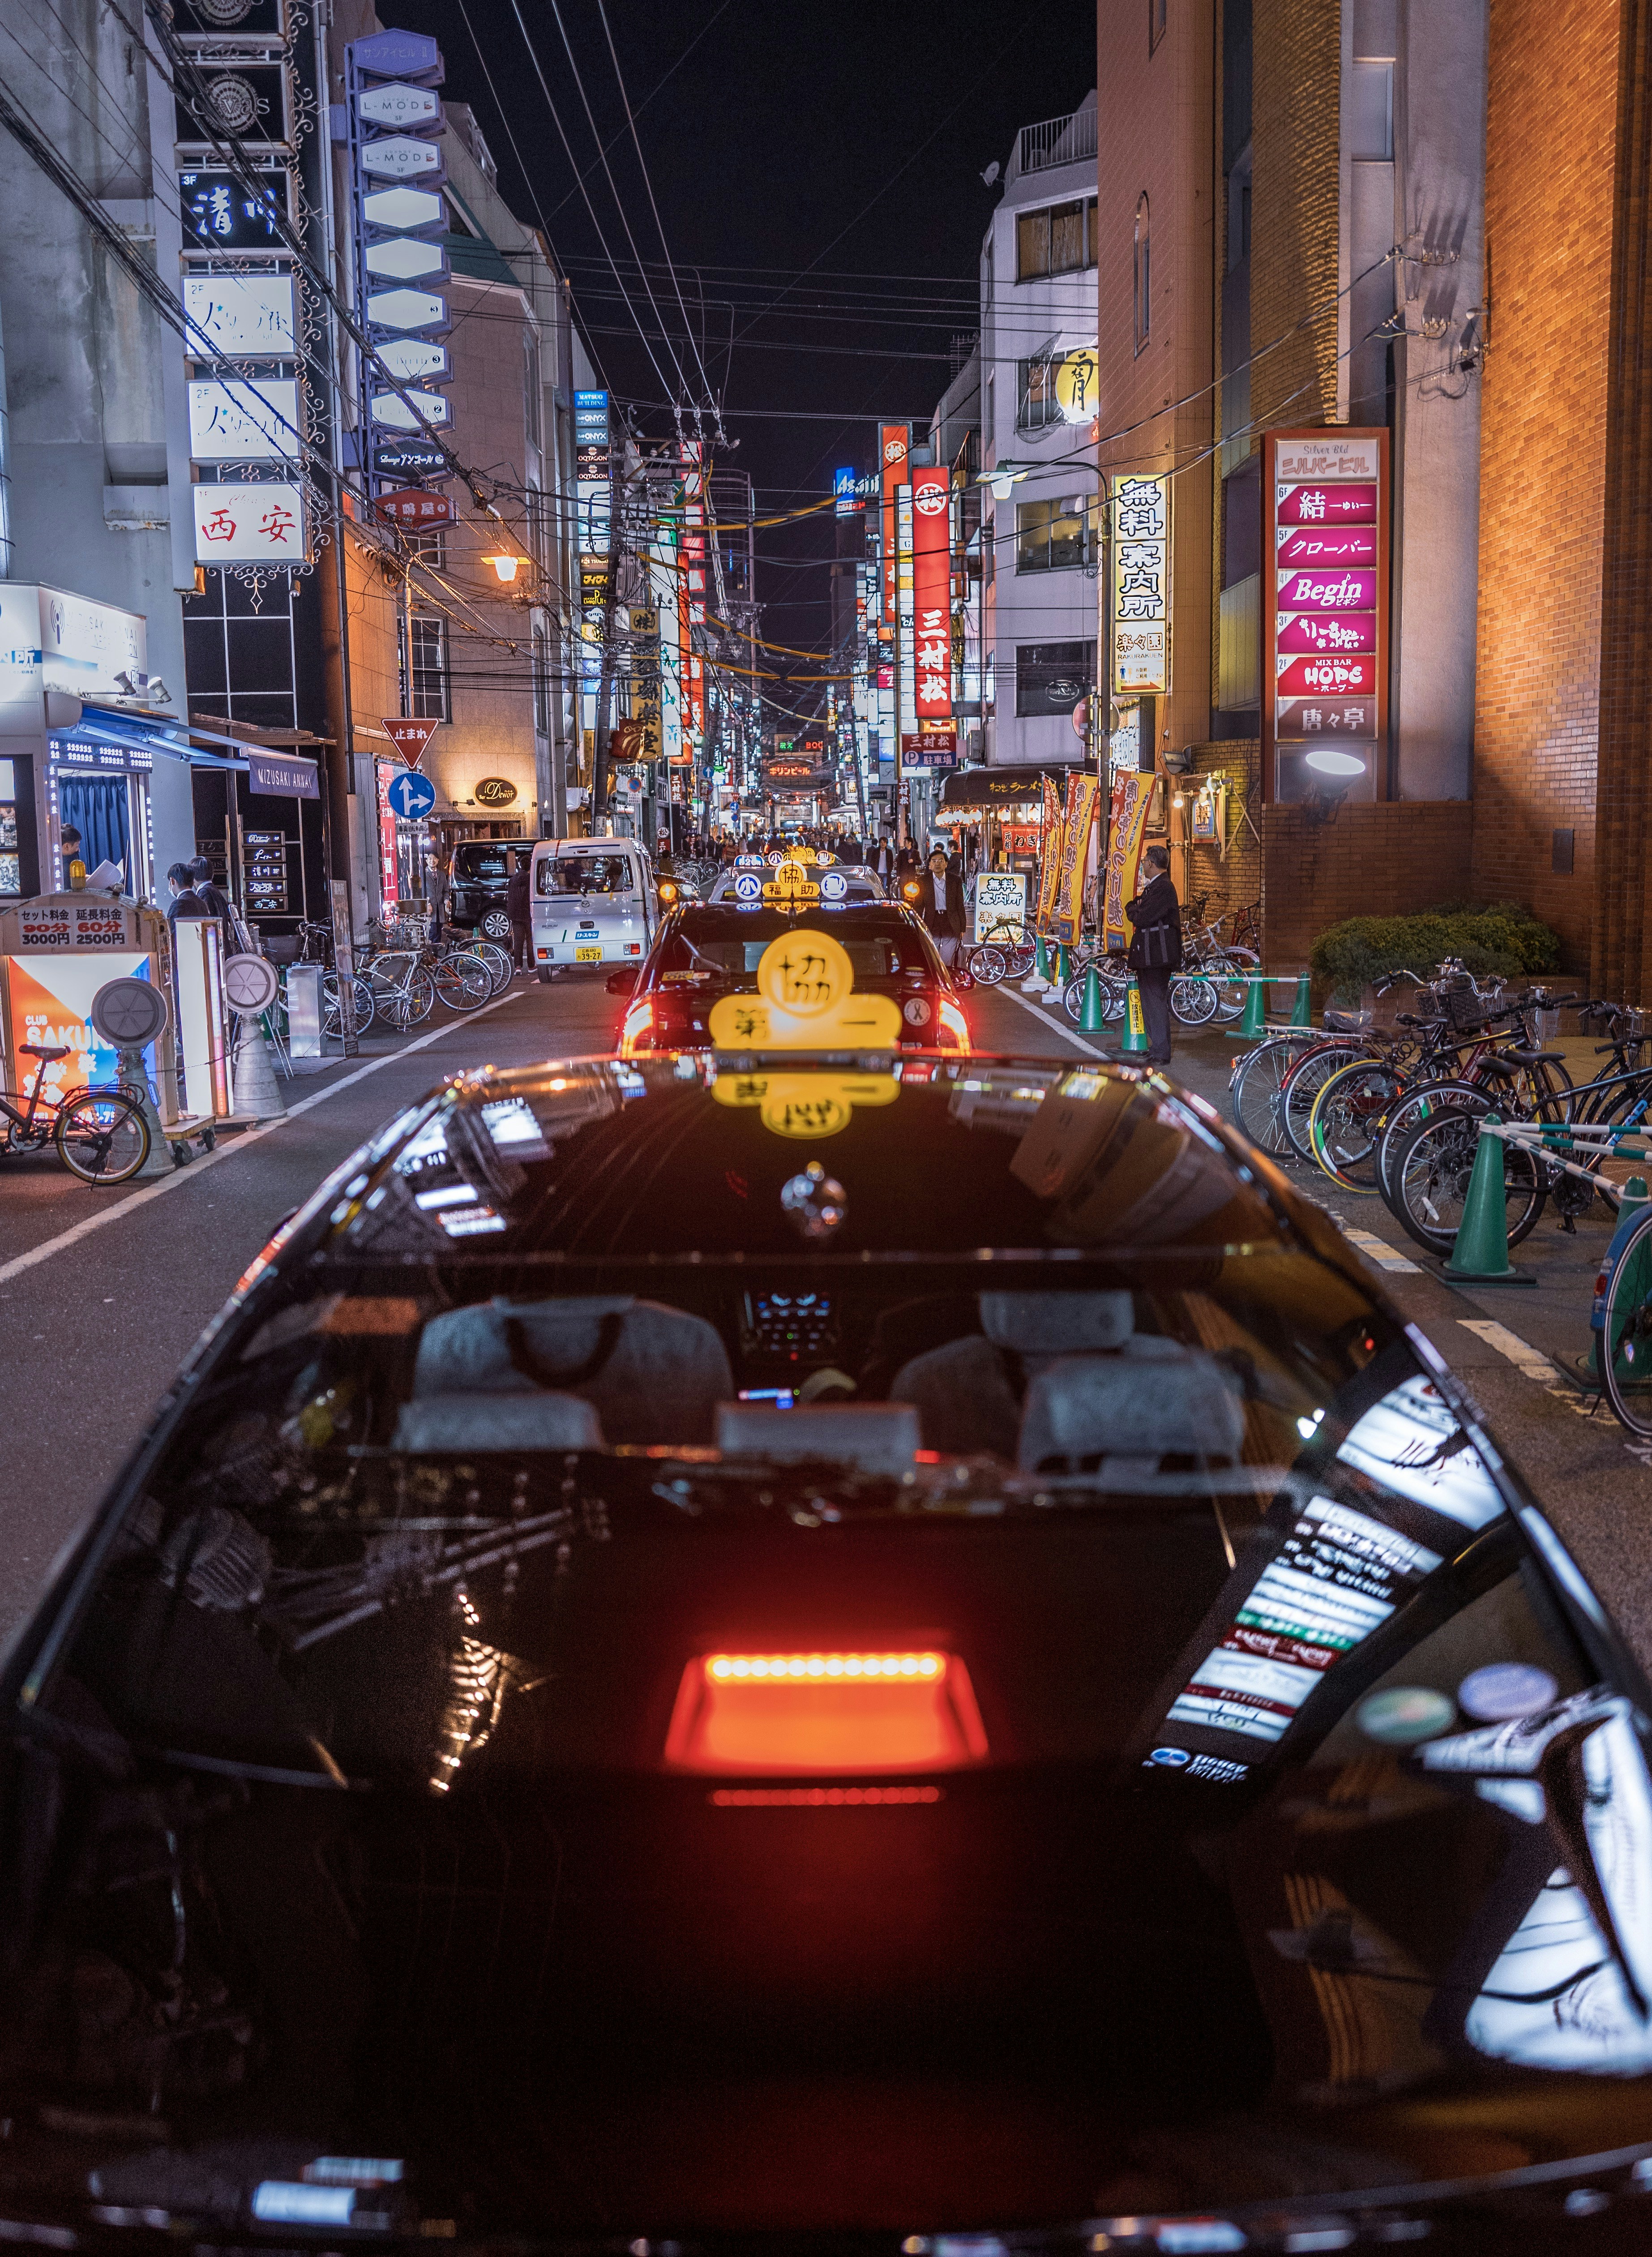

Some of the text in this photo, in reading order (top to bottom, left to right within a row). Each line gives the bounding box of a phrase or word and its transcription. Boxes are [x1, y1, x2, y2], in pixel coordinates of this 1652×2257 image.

[183, 175, 197, 185] 3F
[192, 285, 204, 295] 2F
[197, 389, 209, 398] 2F
[887, 444, 903, 459] 松
[1303, 445, 1349, 454] Silver Bld
[1279, 487, 1288, 498] 6F
[918, 487, 943, 511] 松
[1299, 491, 1326, 519] 結
[202, 505, 296, 543] 西安
[1279, 530, 1288, 541] 5F
[1118, 478, 1164, 619] 無料案内所
[1288, 540, 1372, 557] クローバー
[1279, 573, 1288, 584] 4F
[1292, 573, 1362, 607] Begin
[1336, 597, 1359, 606] ビギン
[1279, 616, 1288, 626] 3F
[917, 609, 949, 703] 三村松
[1279, 659, 1287, 670] 2F
[1304, 666, 1363, 685] HOPE
[1302, 707, 1365, 731] 唐々亭
[394, 728, 428, 739] 止まれ
[910, 734, 950, 747] 三村松
[908, 752, 916, 764] P
[923, 755, 952, 765] 駐車場
[769, 767, 811, 776] キリンビール
[258, 768, 312, 789] MIZUSAKI ANNAI
[484, 782, 514, 800] Dewor
[672, 775, 681, 801] 三村松
[899, 777, 909, 805] 三村松
[1004, 831, 1013, 850] 元祖
[1014, 835, 1037, 847] ねぎ
[770, 853, 779, 863] 小
[782, 868, 799, 883] 協
[738, 878, 758, 895] 小
[769, 884, 814, 895] 福助
[987, 878, 1016, 891] 無料
[979, 891, 1023, 906] 案内所
[21, 909, 69, 921] セット料金
[76, 908, 122, 921] 延長料金
[23, 923, 71, 933] 90分
[77, 921, 122, 933] 60分
[22, 933, 70, 945] 3000円
[76, 933, 125, 945] 2500円
[582, 952, 600, 960] 39-27
[25, 1015, 48, 1026] CLUB
